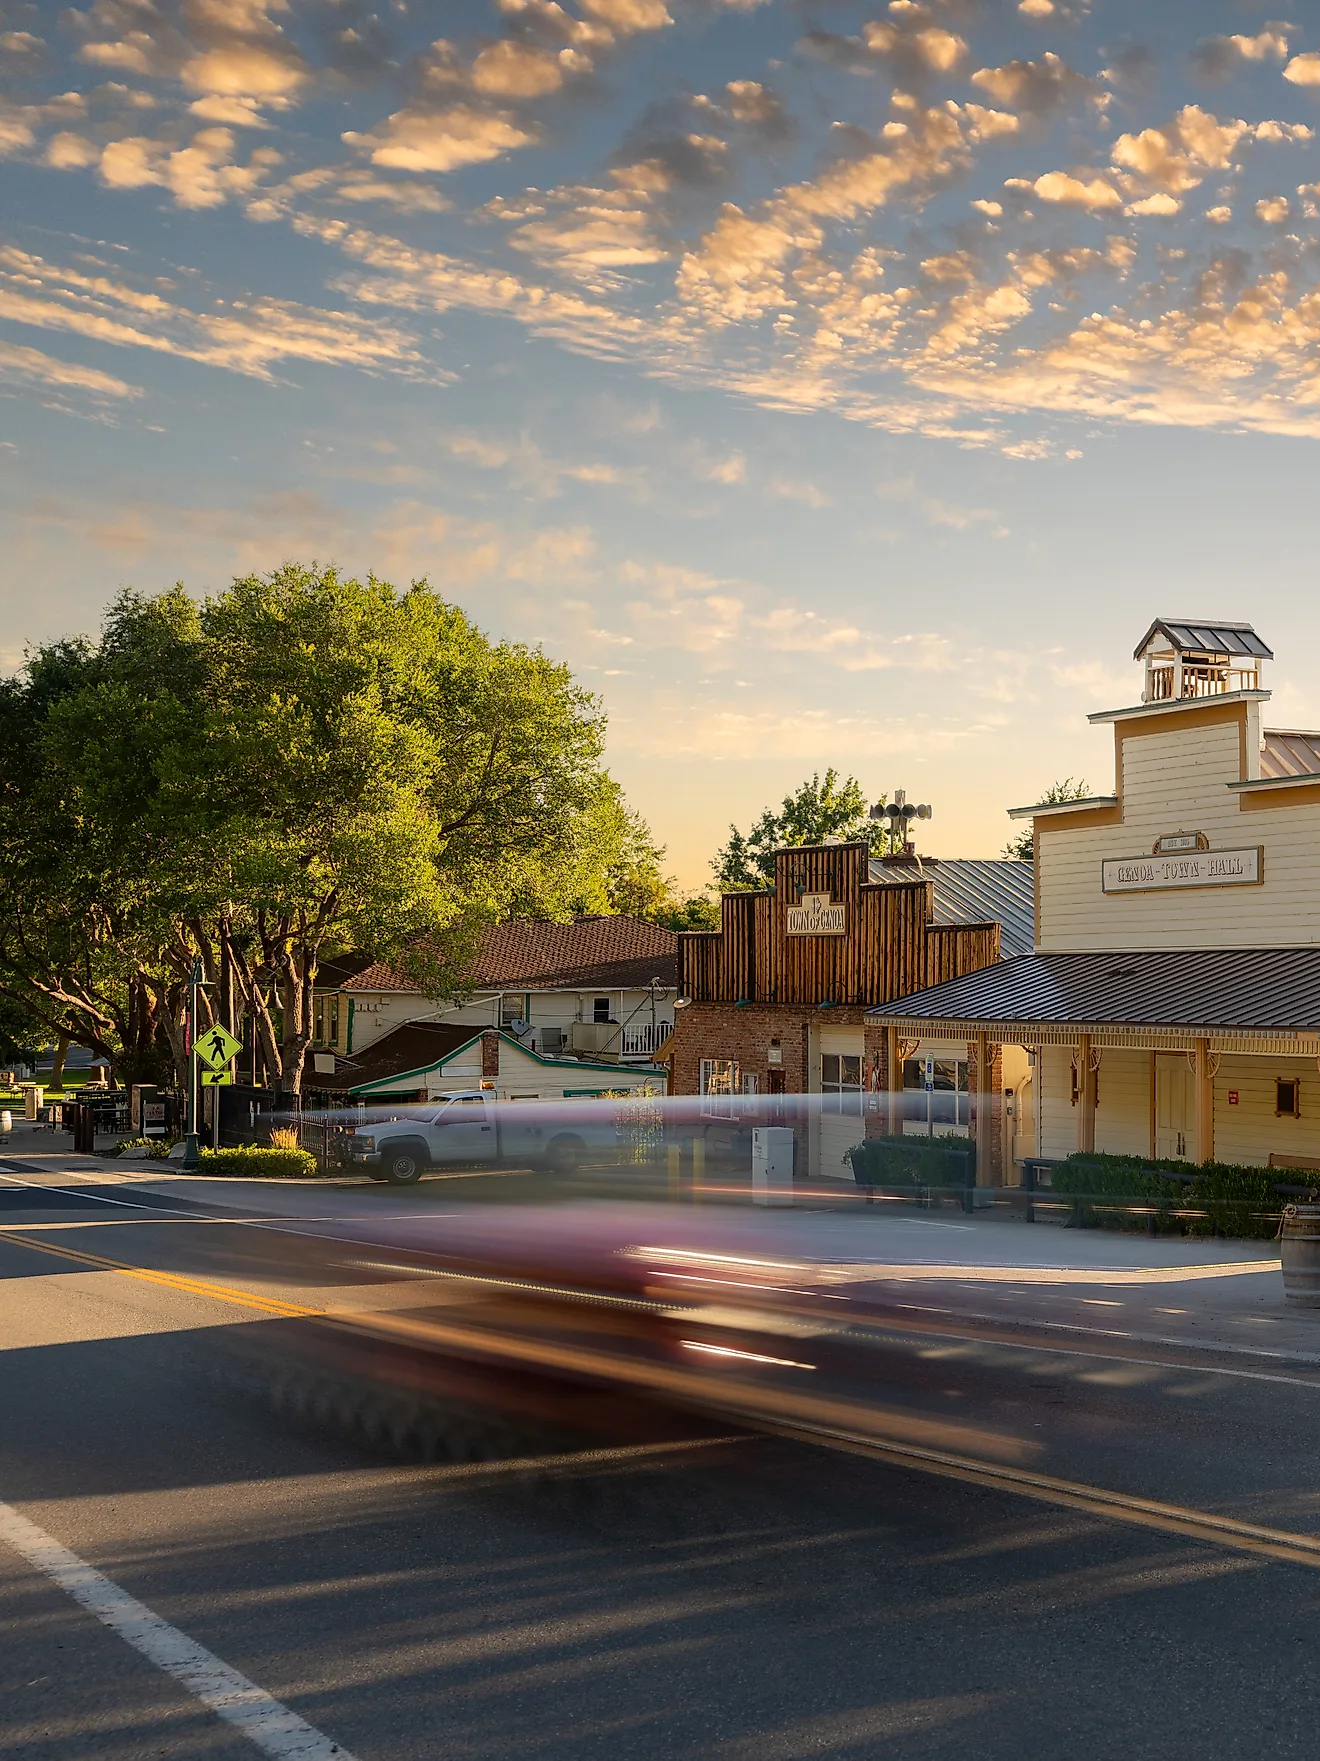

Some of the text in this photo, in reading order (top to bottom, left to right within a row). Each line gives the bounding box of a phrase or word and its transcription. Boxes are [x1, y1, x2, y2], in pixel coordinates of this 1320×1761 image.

[1117, 858, 1244, 883] GENOA TOWN HALL
[787, 910, 809, 931] TOWN
[820, 908, 844, 930] GENOA
